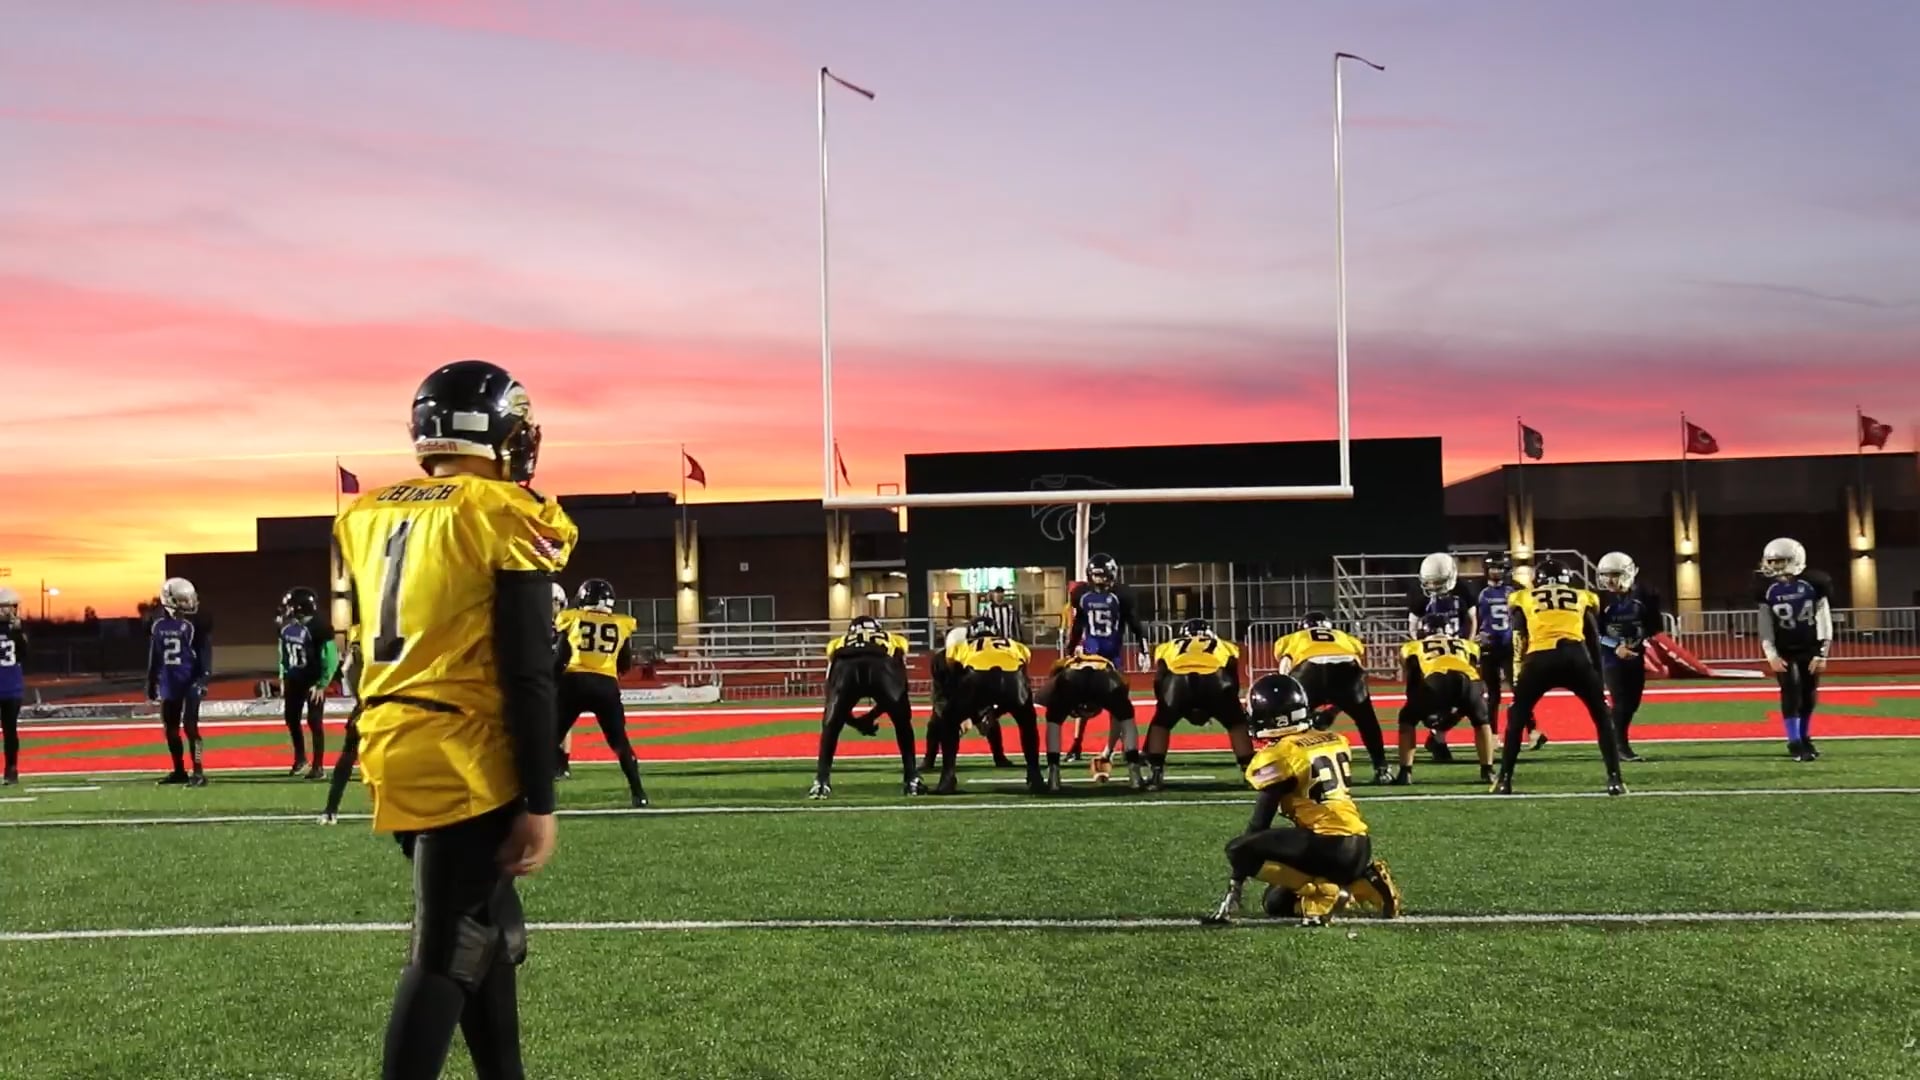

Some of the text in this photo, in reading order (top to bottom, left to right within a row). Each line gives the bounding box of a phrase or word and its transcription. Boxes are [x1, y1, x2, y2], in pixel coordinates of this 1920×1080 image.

[374, 521, 408, 662] 1
[1531, 589, 1578, 612] 32
[1088, 610, 1112, 637] 15
[1773, 600, 1815, 629] 84
[578, 621, 619, 653] 39
[1175, 637, 1217, 655] 77
[1310, 629, 1335, 642] 6
[164, 638, 181, 665] 2
[286, 643, 307, 668] 10
